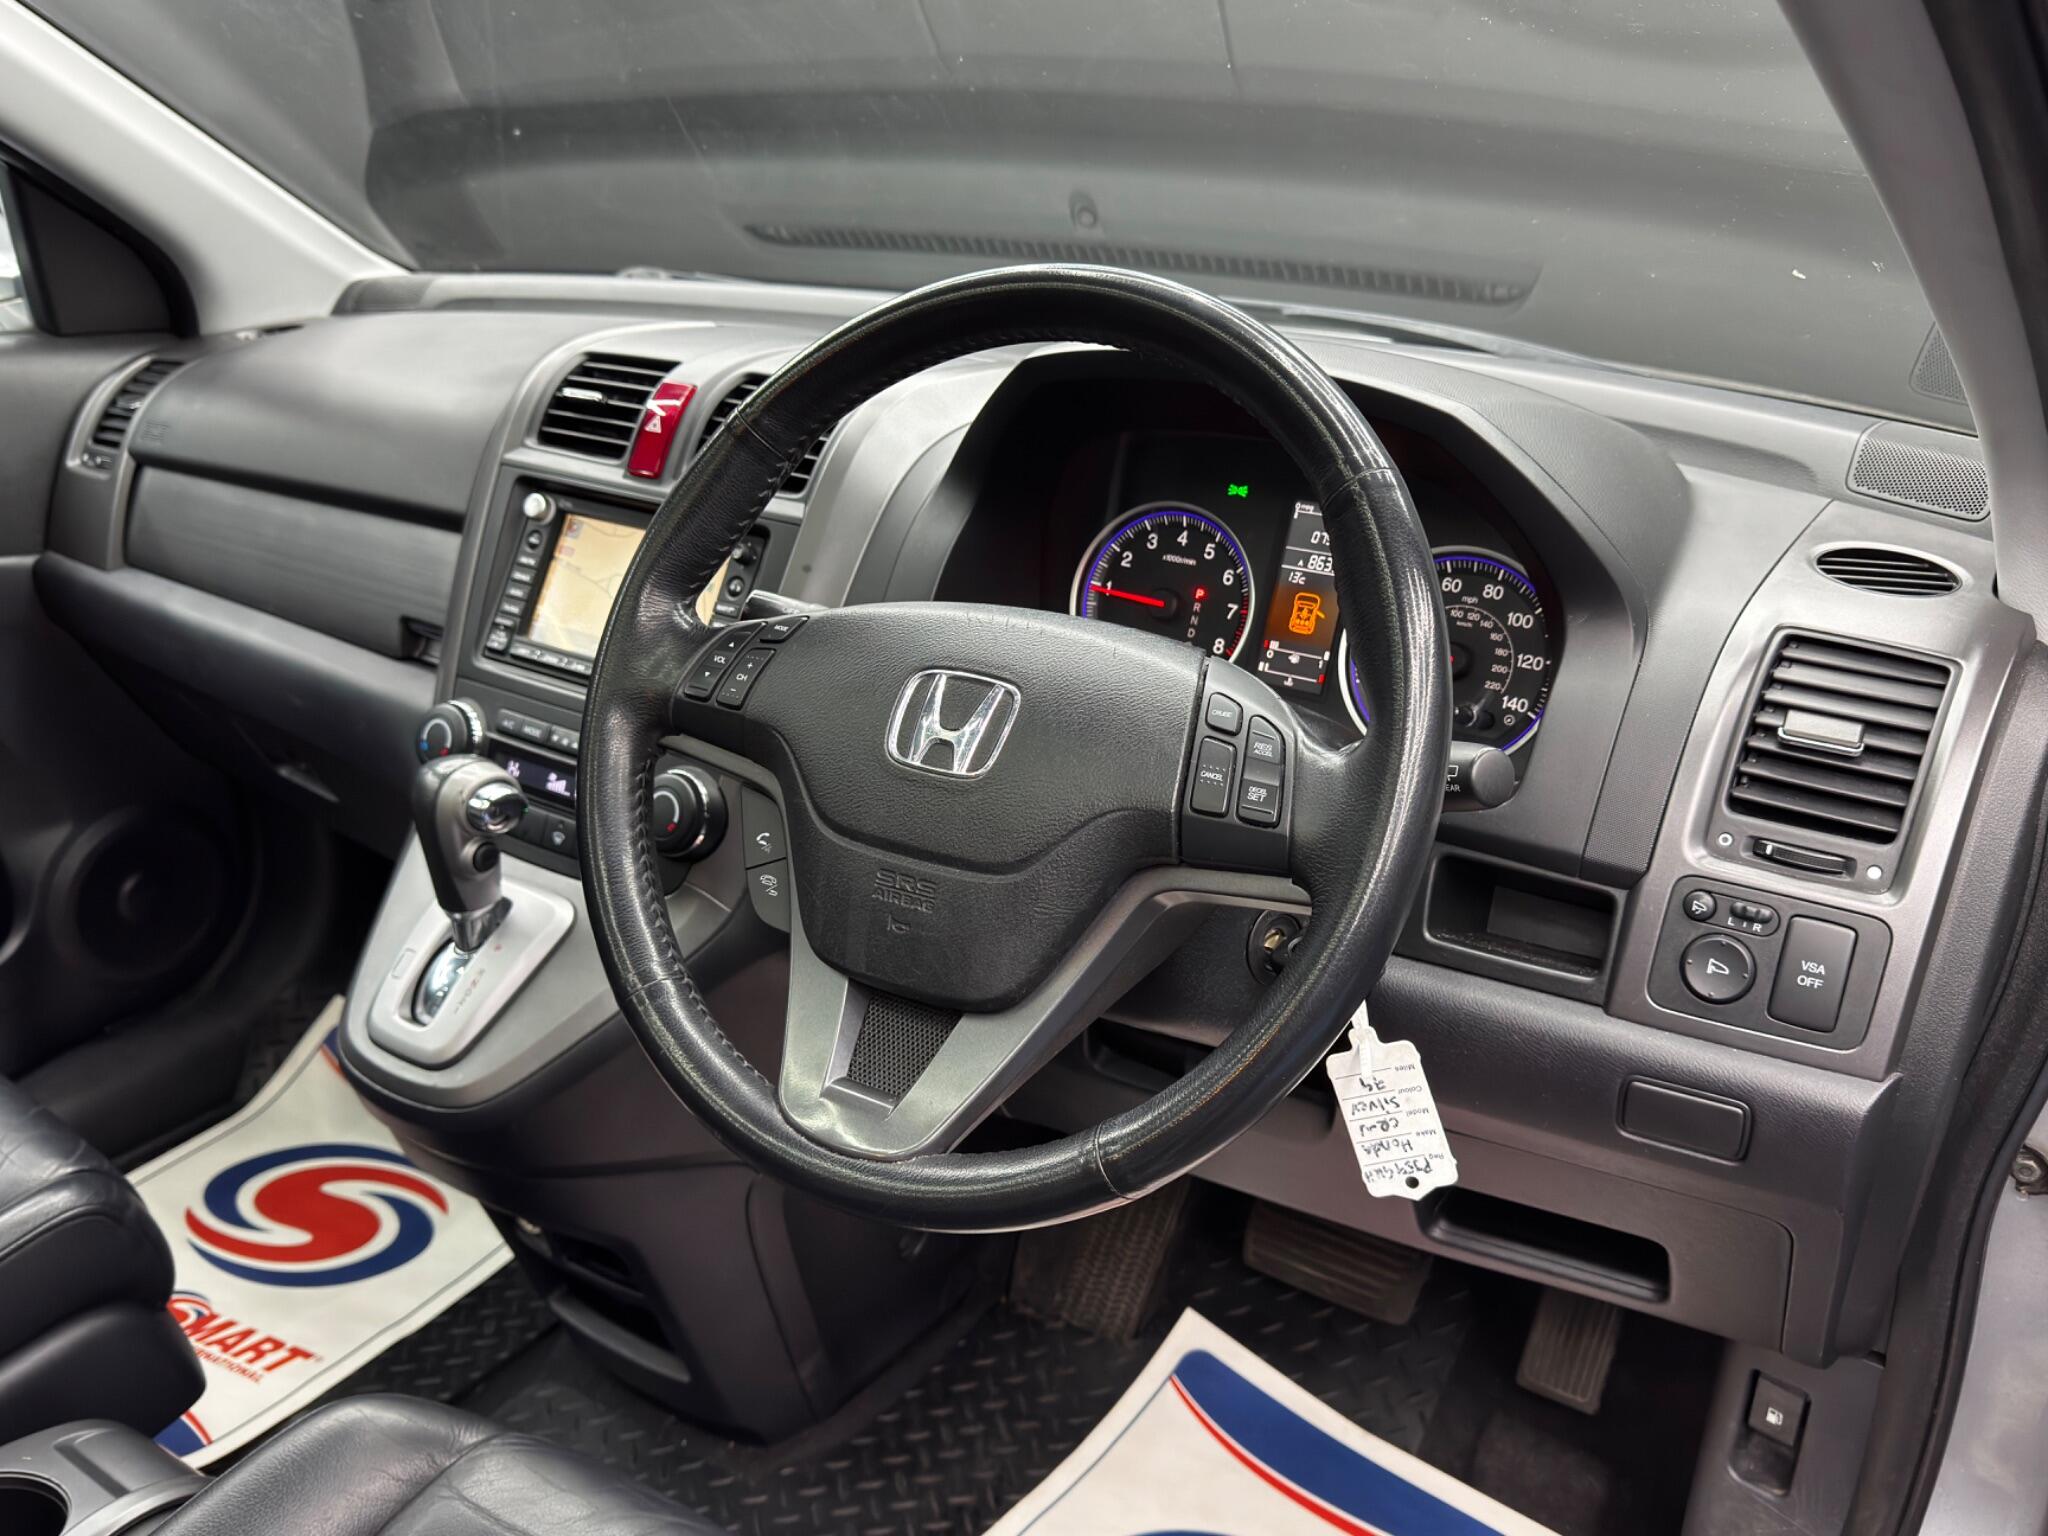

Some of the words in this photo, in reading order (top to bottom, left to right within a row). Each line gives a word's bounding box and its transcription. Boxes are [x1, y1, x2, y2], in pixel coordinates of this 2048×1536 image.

[1146, 533, 1159, 550] 3
[1177, 530, 1189, 547] 4
[1120, 551, 1133, 567] 2
[1203, 543, 1216, 560] 5
[1222, 569, 1235, 585] 6
[1441, 576, 1462, 593] 60
[1195, 588, 1204, 599] P
[1482, 583, 1504, 600] 80
[1193, 602, 1201, 612] R
[1226, 603, 1239, 620] 7
[1450, 609, 1464, 619] 100
[1190, 615, 1199, 625] N
[1467, 612, 1480, 621] 120
[1506, 611, 1534, 629] 100
[1480, 620, 1494, 629] 140
[1187, 627, 1196, 638] D
[1212, 638, 1226, 654] 8
[714, 655, 726, 664] VOL
[1516, 653, 1545, 671] 120
[1491, 664, 1508, 674] 200
[1484, 680, 1501, 690] 220
[1501, 695, 1529, 713] 140
[1200, 770, 1224, 781] CANCEL
[1445, 784, 1461, 792] EAR
[874, 868, 938, 899] SRS
[871, 888, 936, 914] AIRBAG
[1727, 917, 1735, 927] L
[1752, 923, 1762, 933] R
[1801, 960, 1826, 975] VSA
[1797, 975, 1824, 989] OFF
[1398, 1085, 1423, 1094] Colour
